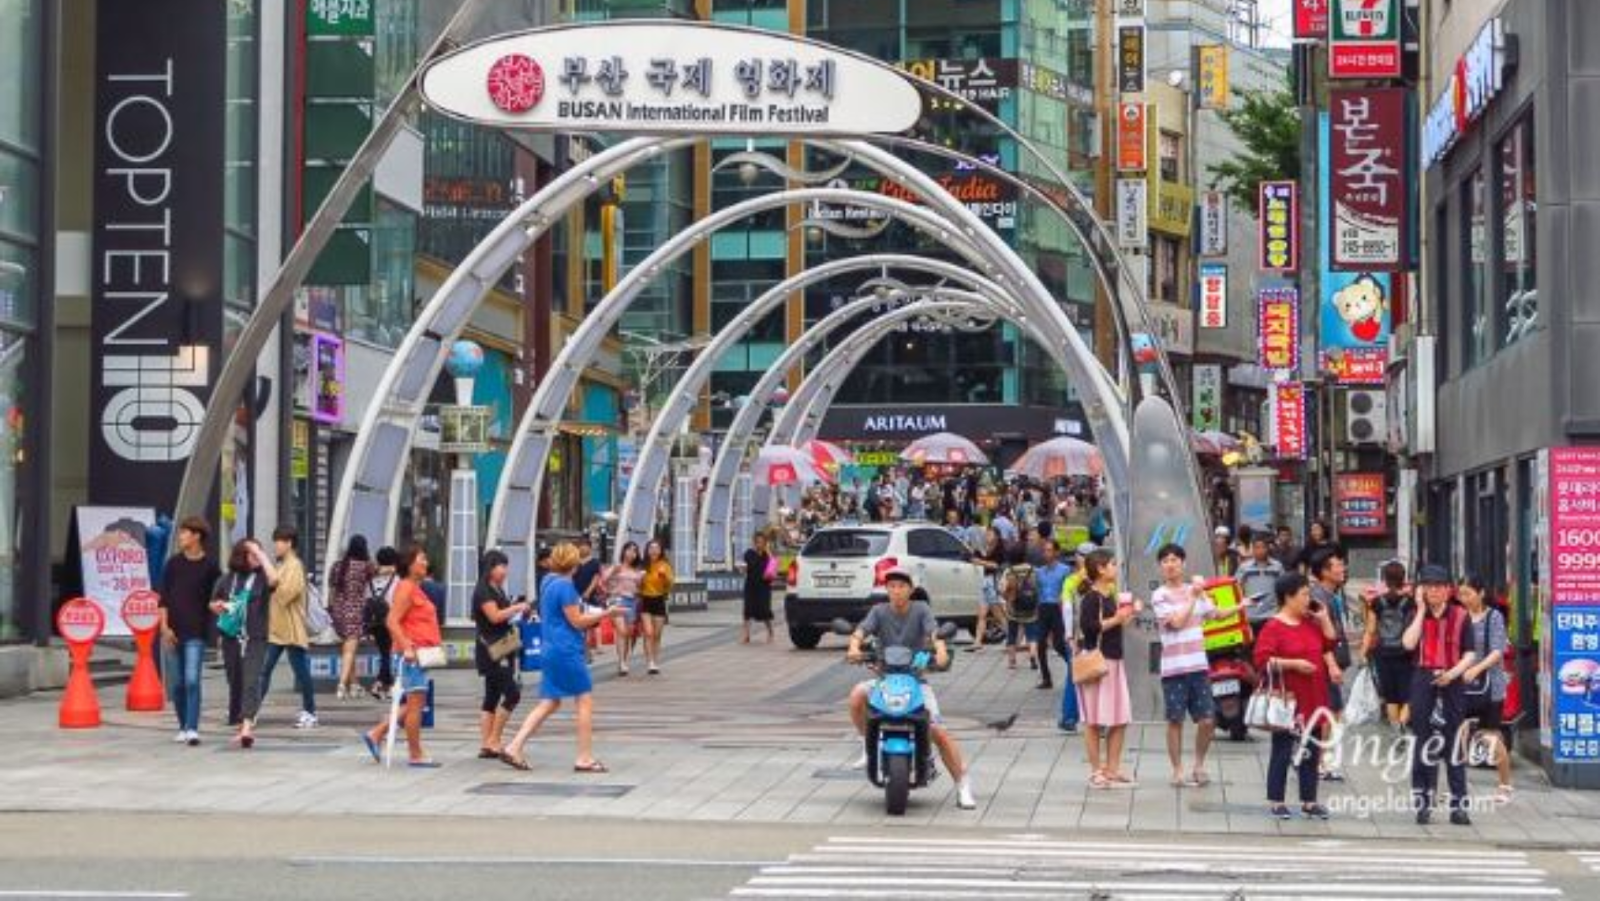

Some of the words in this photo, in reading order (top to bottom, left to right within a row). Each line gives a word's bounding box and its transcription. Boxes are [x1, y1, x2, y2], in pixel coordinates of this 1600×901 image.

[559, 56, 629, 95] 부산
[646, 58, 713, 97] 국제
[735, 60, 837, 99] 영화제
[558, 102, 622, 119] BUSAN
[626, 103, 725, 121] International
[729, 105, 762, 121] Film
[768, 106, 829, 123] Festival
[1334, 97, 1399, 206] 본죽
[864, 415, 946, 431] ARITAUM
[1557, 553, 1600, 570] 999
